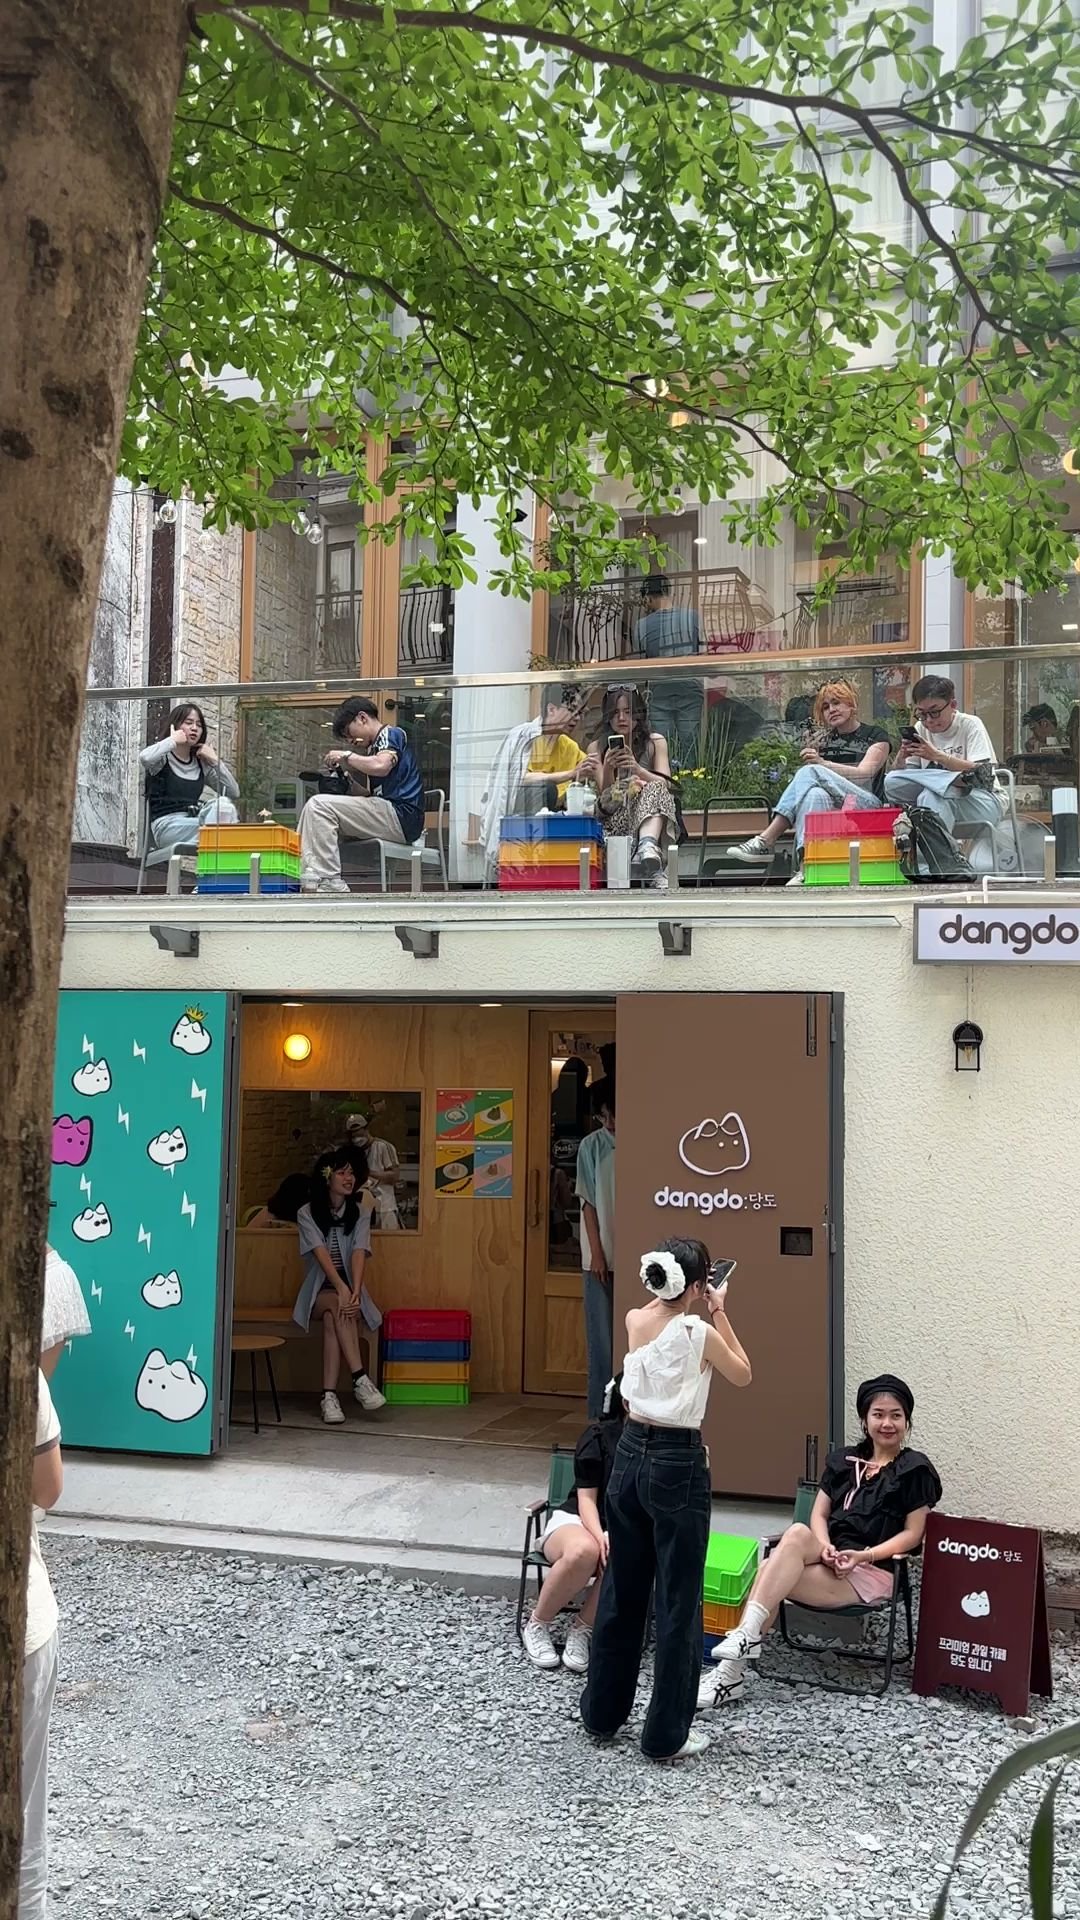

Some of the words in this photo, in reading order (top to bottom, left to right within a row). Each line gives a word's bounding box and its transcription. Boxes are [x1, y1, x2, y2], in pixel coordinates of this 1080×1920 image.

[939, 914, 1079, 954] dangdo
[939, 1637, 970, 1654] 프리미엄
[971, 1643, 988, 1658] 과일
[989, 1646, 1007, 1661] 카페
[950, 1653, 966, 1667] 당도
[968, 1656, 992, 1673] 입니다
